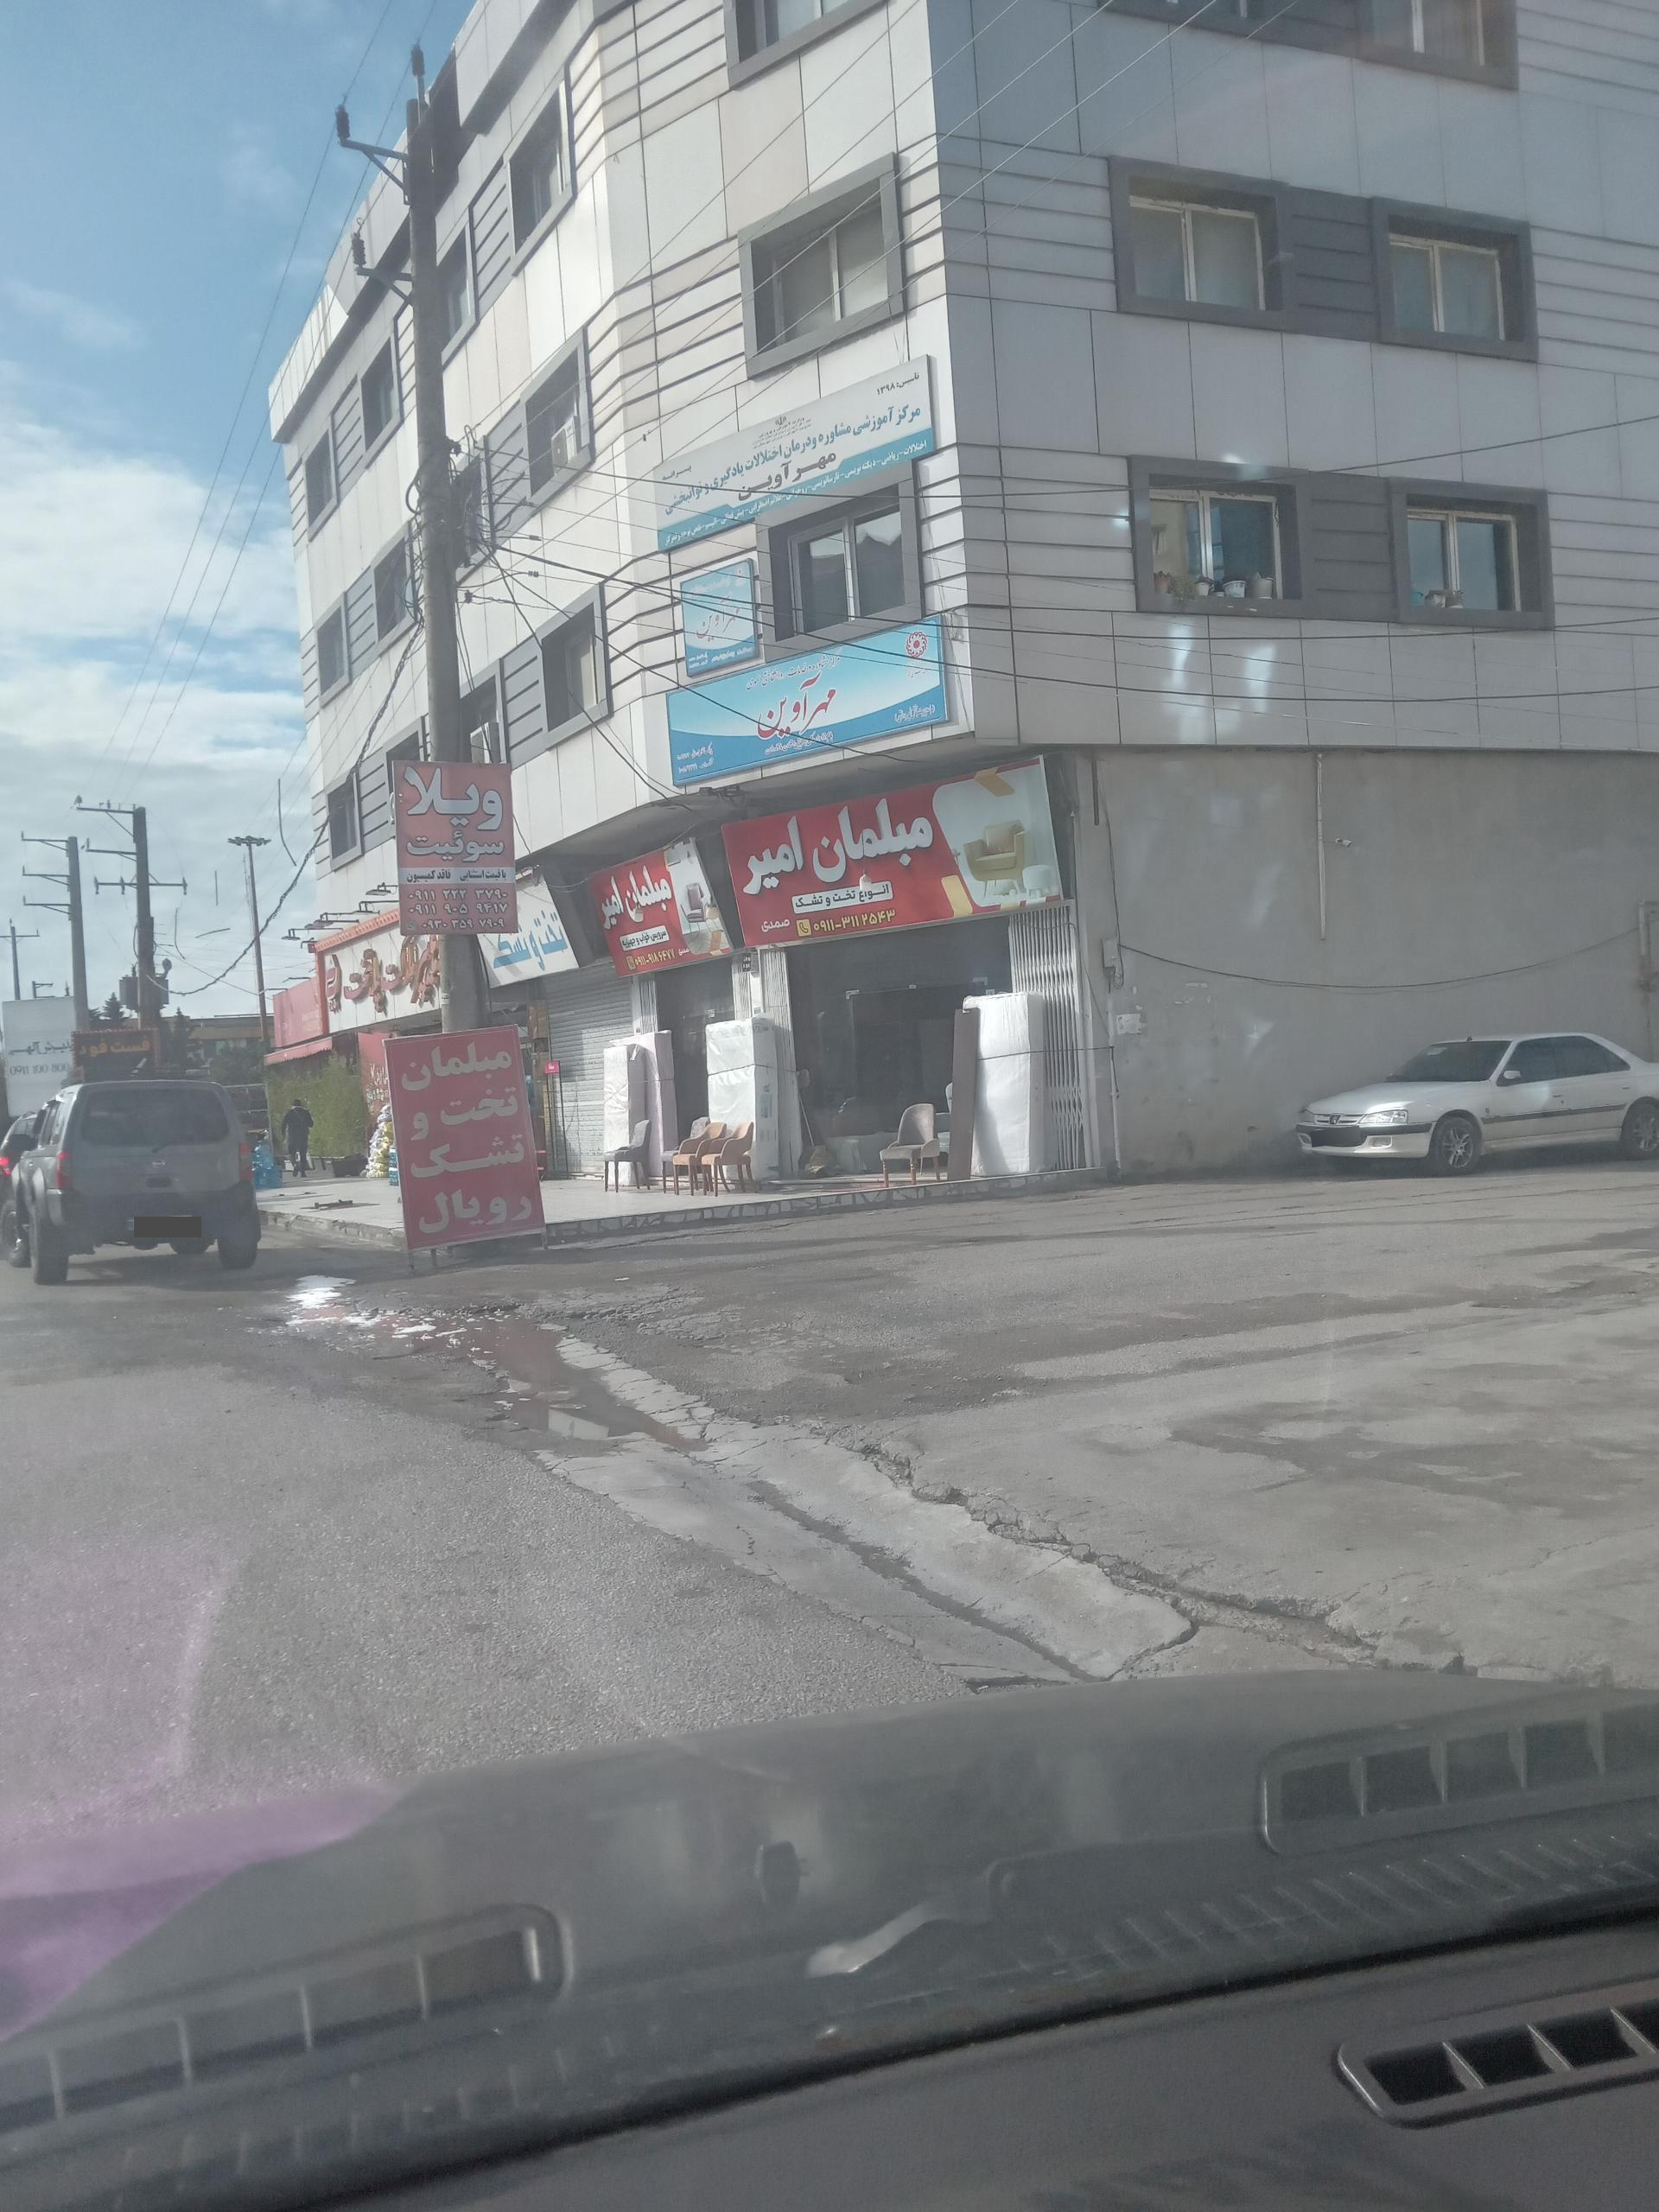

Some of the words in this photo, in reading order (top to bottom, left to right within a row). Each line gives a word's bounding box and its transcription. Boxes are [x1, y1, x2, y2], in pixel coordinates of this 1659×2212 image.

[853, 406, 894, 435] آموزشی
[896, 404, 920, 425] مرکز
[818, 423, 851, 445] مشاوره
[745, 444, 782, 471] اختلالات
[792, 453, 836, 482] مهر
[738, 461, 791, 500] آوین
[664, 482, 702, 515] توانبخشی
[757, 671, 822, 740] آوین
[404, 766, 504, 830] ویلا
[406, 830, 505, 862] سوئیت
[811, 797, 934, 883] مبلمان
[742, 815, 804, 896] امیر
[406, 868, 435, 882] کمیسیون
[436, 869, 451, 880] فاقد
[408, 888, 436, 900] ۰۹۱۱
[474, 887, 508, 899] ۳۷۹۰
[601, 875, 624, 931] امیر
[624, 865, 672, 924] مبلمان
[794, 893, 823, 908] تشک
[825, 897, 831, 906] و
[832, 889, 856, 902] تخت
[858, 883, 890, 902] انواع
[409, 902, 437, 914] ۰۹۱۱
[443, 902, 469, 914] ۹۰۵
[476, 902, 509, 913] ۹۴۱۷
[422, 918, 448, 930] ۰۹۳۰
[479, 917, 505, 928] ۷۹۰۹
[533, 909, 568, 955] تخت
[760, 918, 791, 933] صمدی
[528, 930, 546, 971] و
[80, 1039, 107, 1058] فود
[110, 1036, 150, 1052] فست
[401, 1041, 512, 1091] مبلمان
[440, 1085, 518, 1126] تخت
[410, 1111, 429, 1141] و
[410, 1133, 525, 1179] تشک
[417, 1188, 533, 1235] رویال
